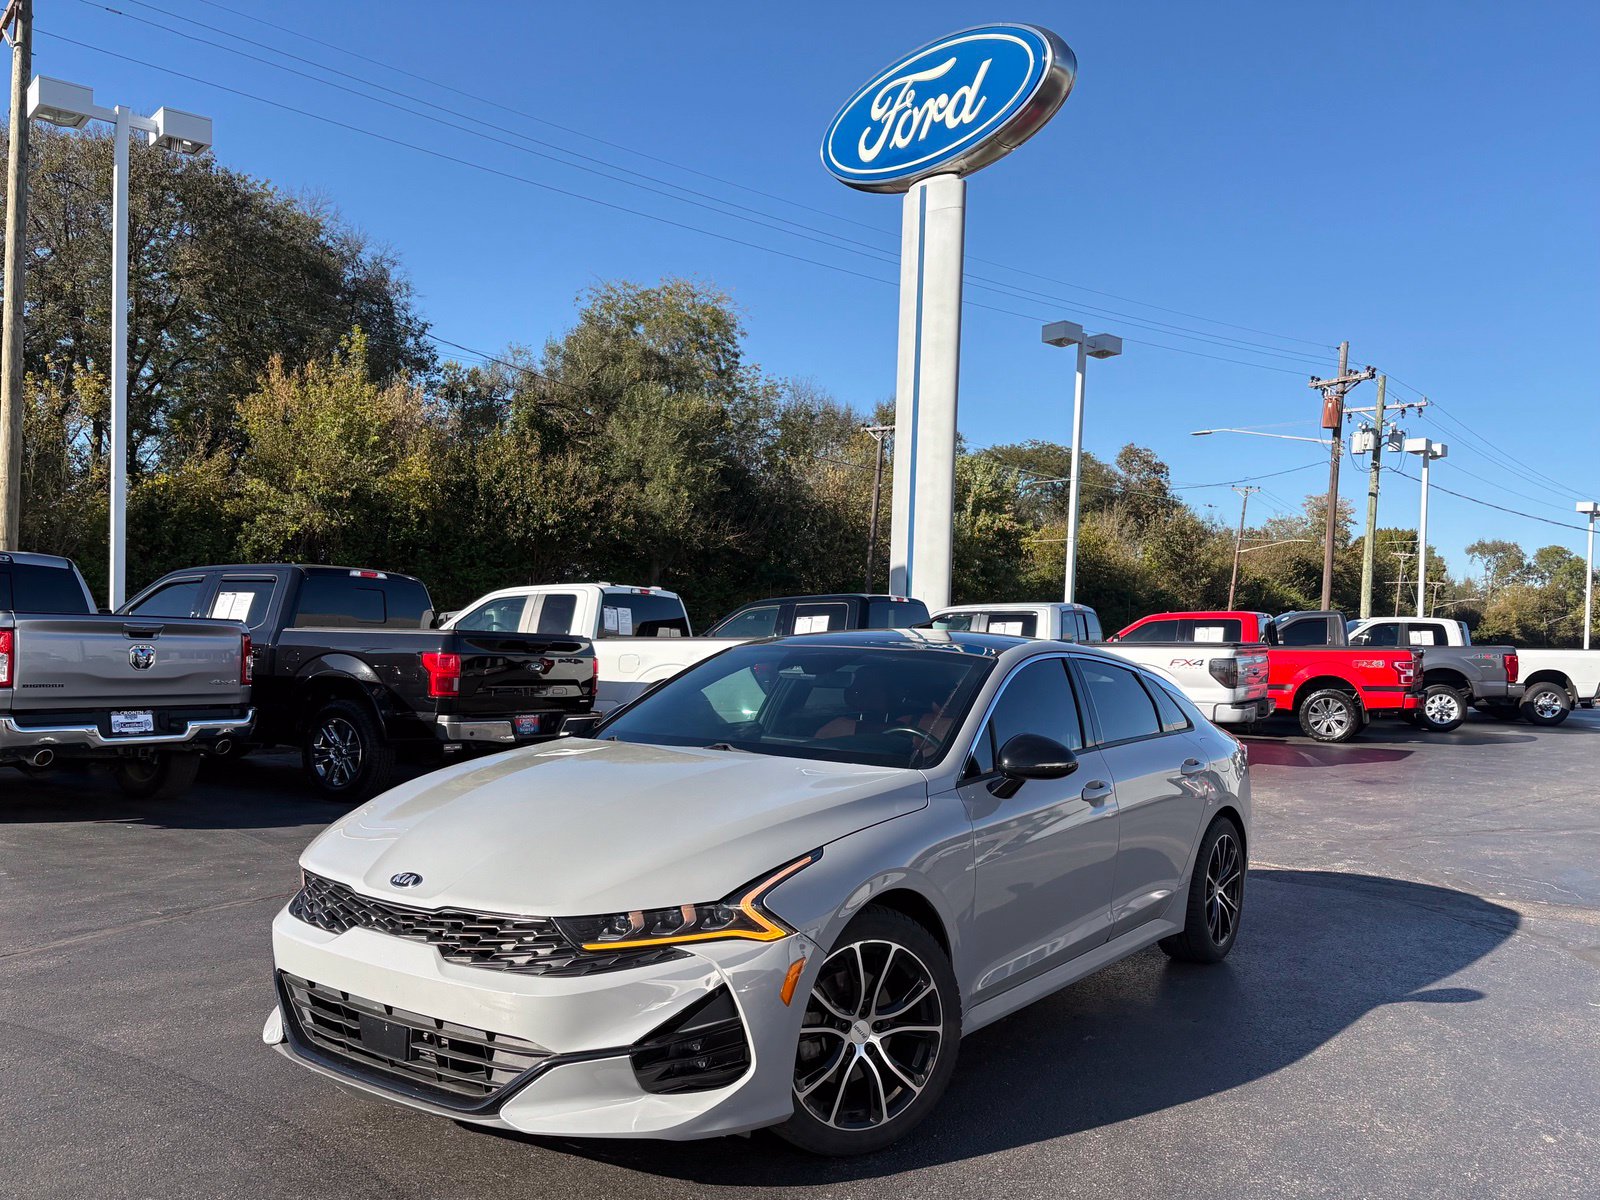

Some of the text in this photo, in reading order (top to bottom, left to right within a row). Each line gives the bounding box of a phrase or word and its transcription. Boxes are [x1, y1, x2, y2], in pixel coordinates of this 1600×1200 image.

[858, 57, 992, 162] Ford
[1352, 660, 1385, 668] FX4
[392, 872, 417, 887] KIA
